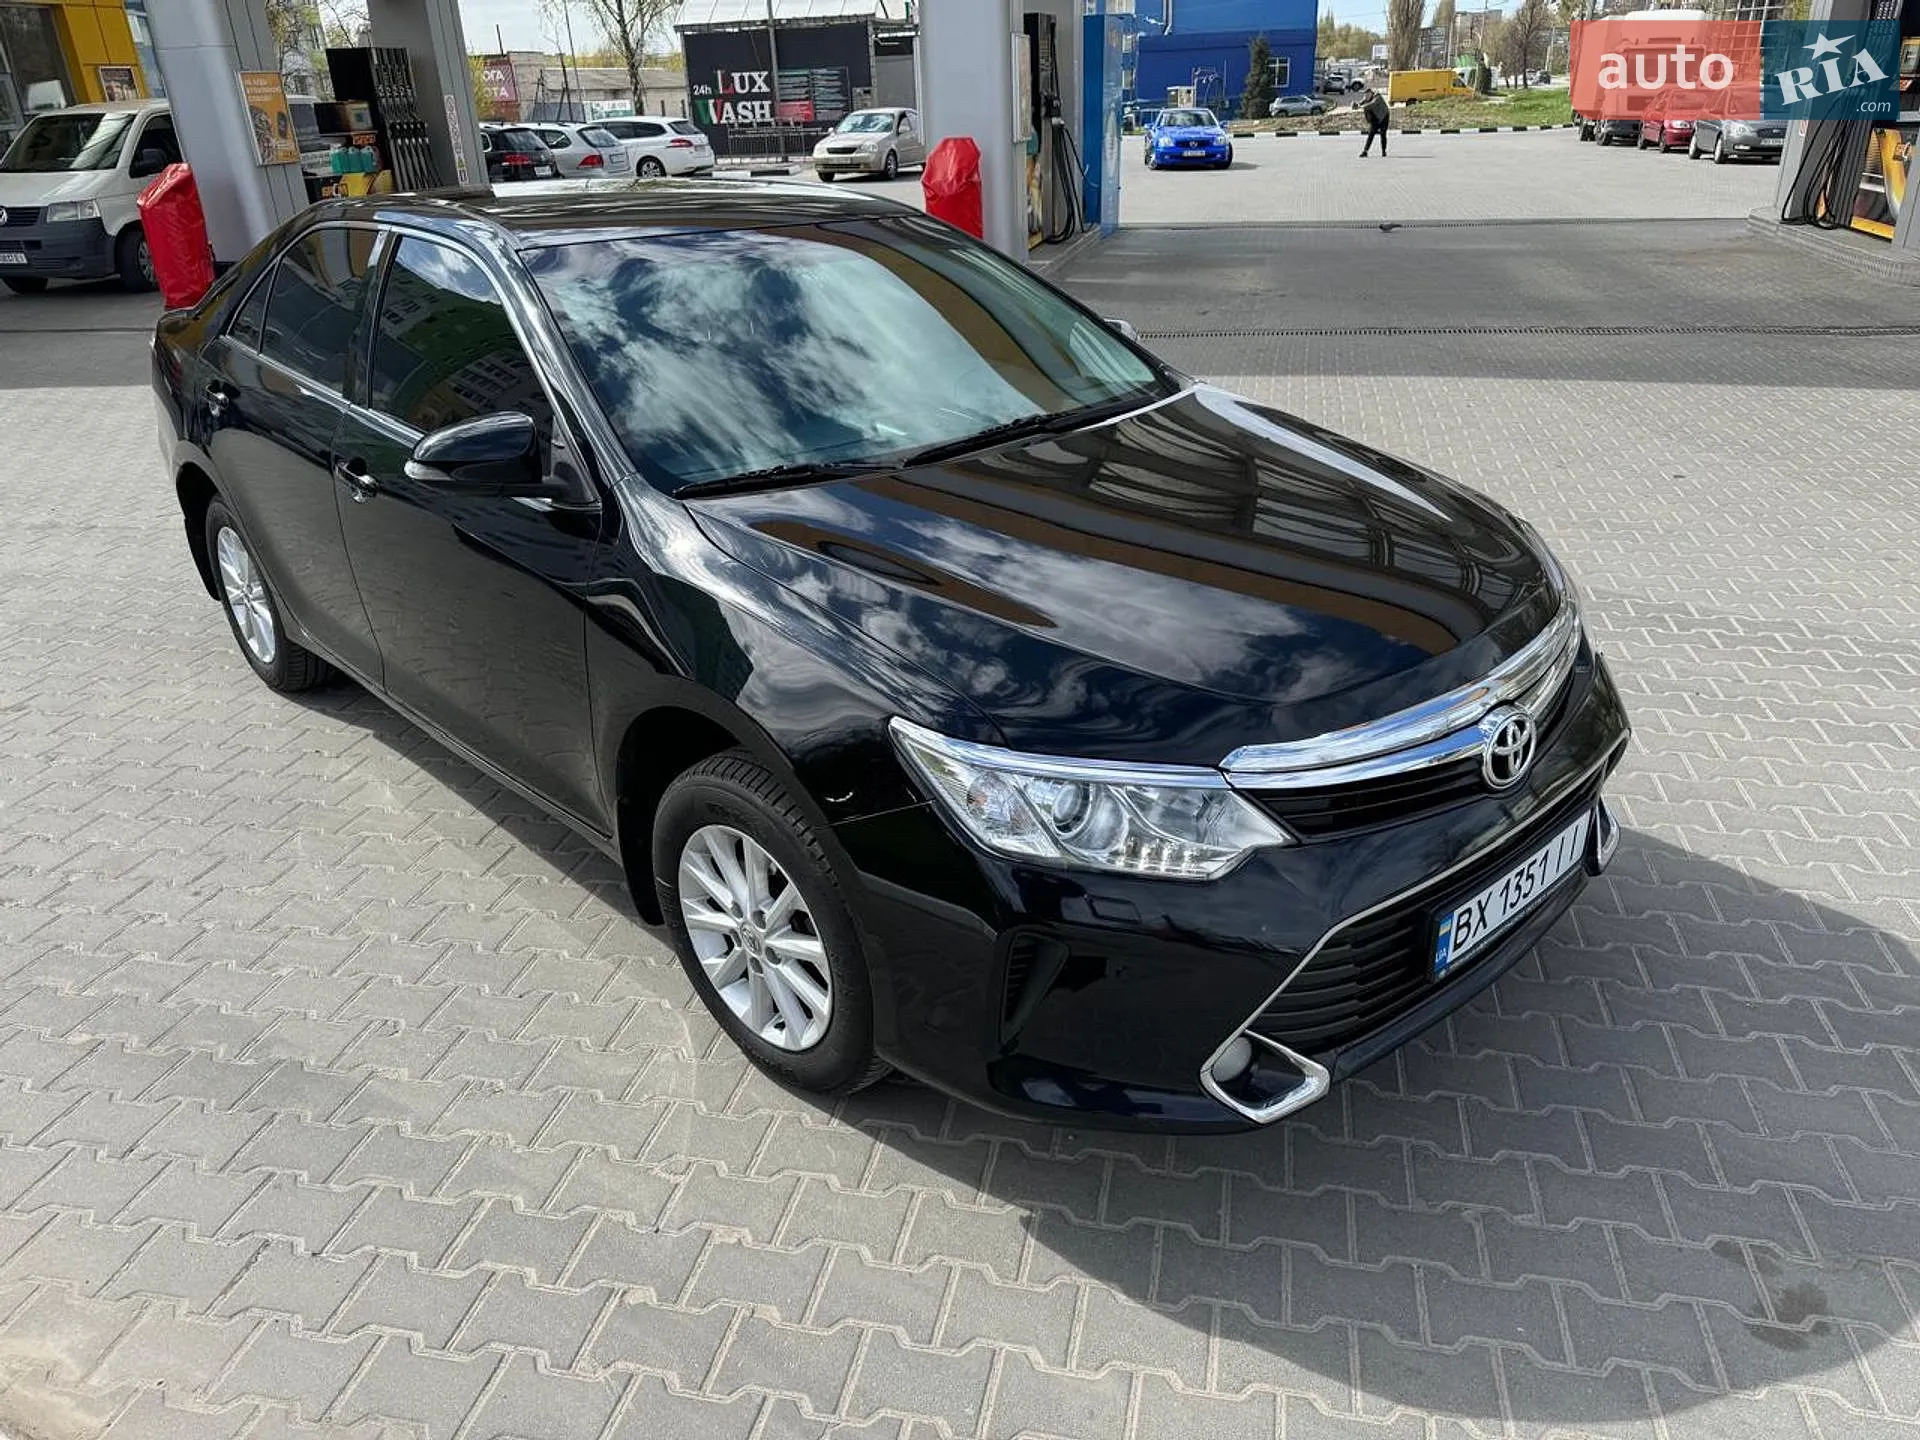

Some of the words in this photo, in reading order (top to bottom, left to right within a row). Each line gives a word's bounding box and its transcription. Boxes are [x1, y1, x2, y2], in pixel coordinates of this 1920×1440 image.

[692, 84, 712, 96] 24h
[714, 69, 771, 96] LUX
[695, 98, 774, 125] WASH
[1453, 892, 1493, 953] BX
[1500, 849, 1550, 916] 1351
